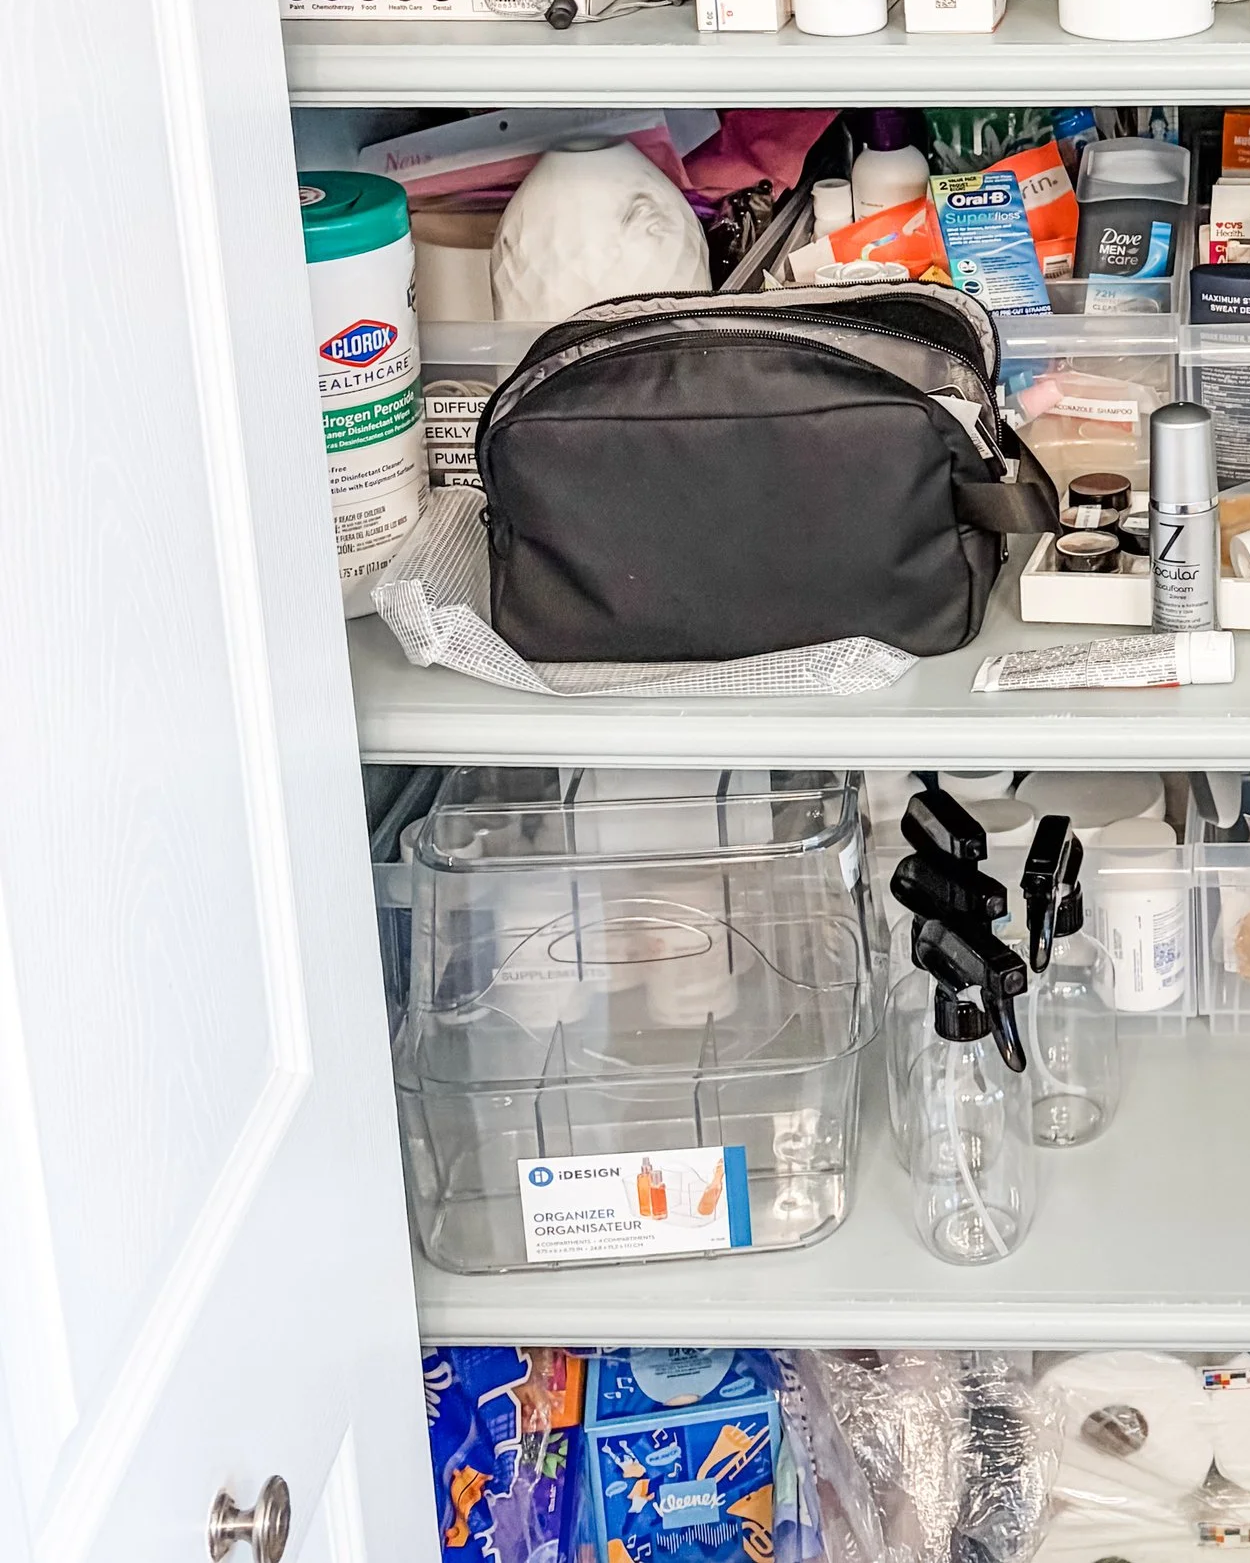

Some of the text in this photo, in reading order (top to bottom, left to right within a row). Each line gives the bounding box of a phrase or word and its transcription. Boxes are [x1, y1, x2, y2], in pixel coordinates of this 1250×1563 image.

[289, 3, 305, 11] Paint
[311, 3, 355, 12] Chemotherapy
[939, 181, 949, 190] 2
[951, 191, 1007, 207] Oral-B
[945, 209, 1021, 225] Superfloss
[1225, 221, 1243, 229] CVS
[1101, 227, 1142, 246] Dove
[1099, 244, 1126, 255] MEN
[1201, 293, 1241, 305] MAXIMUM
[1210, 304, 1237, 314] SWEAT
[331, 326, 393, 359] CLOROX
[374, 390, 415, 418] Peroxide
[1097, 406, 1133, 416] SHAMPOO
[347, 417, 394, 436] Disinfectant
[341, 467, 381, 482] Disinfectant
[348, 483, 364, 492] with
[1158, 522, 1187, 564] Z
[558, 1167, 621, 1181] iDESIGN
[533, 1208, 616, 1224] ORGANIZER
[534, 1220, 643, 1237] ORGANISATEUR
[540, 1234, 656, 1248] COMPARTMENTS COMPARTIMENTS
[653, 1492, 727, 1518] Kleenex
